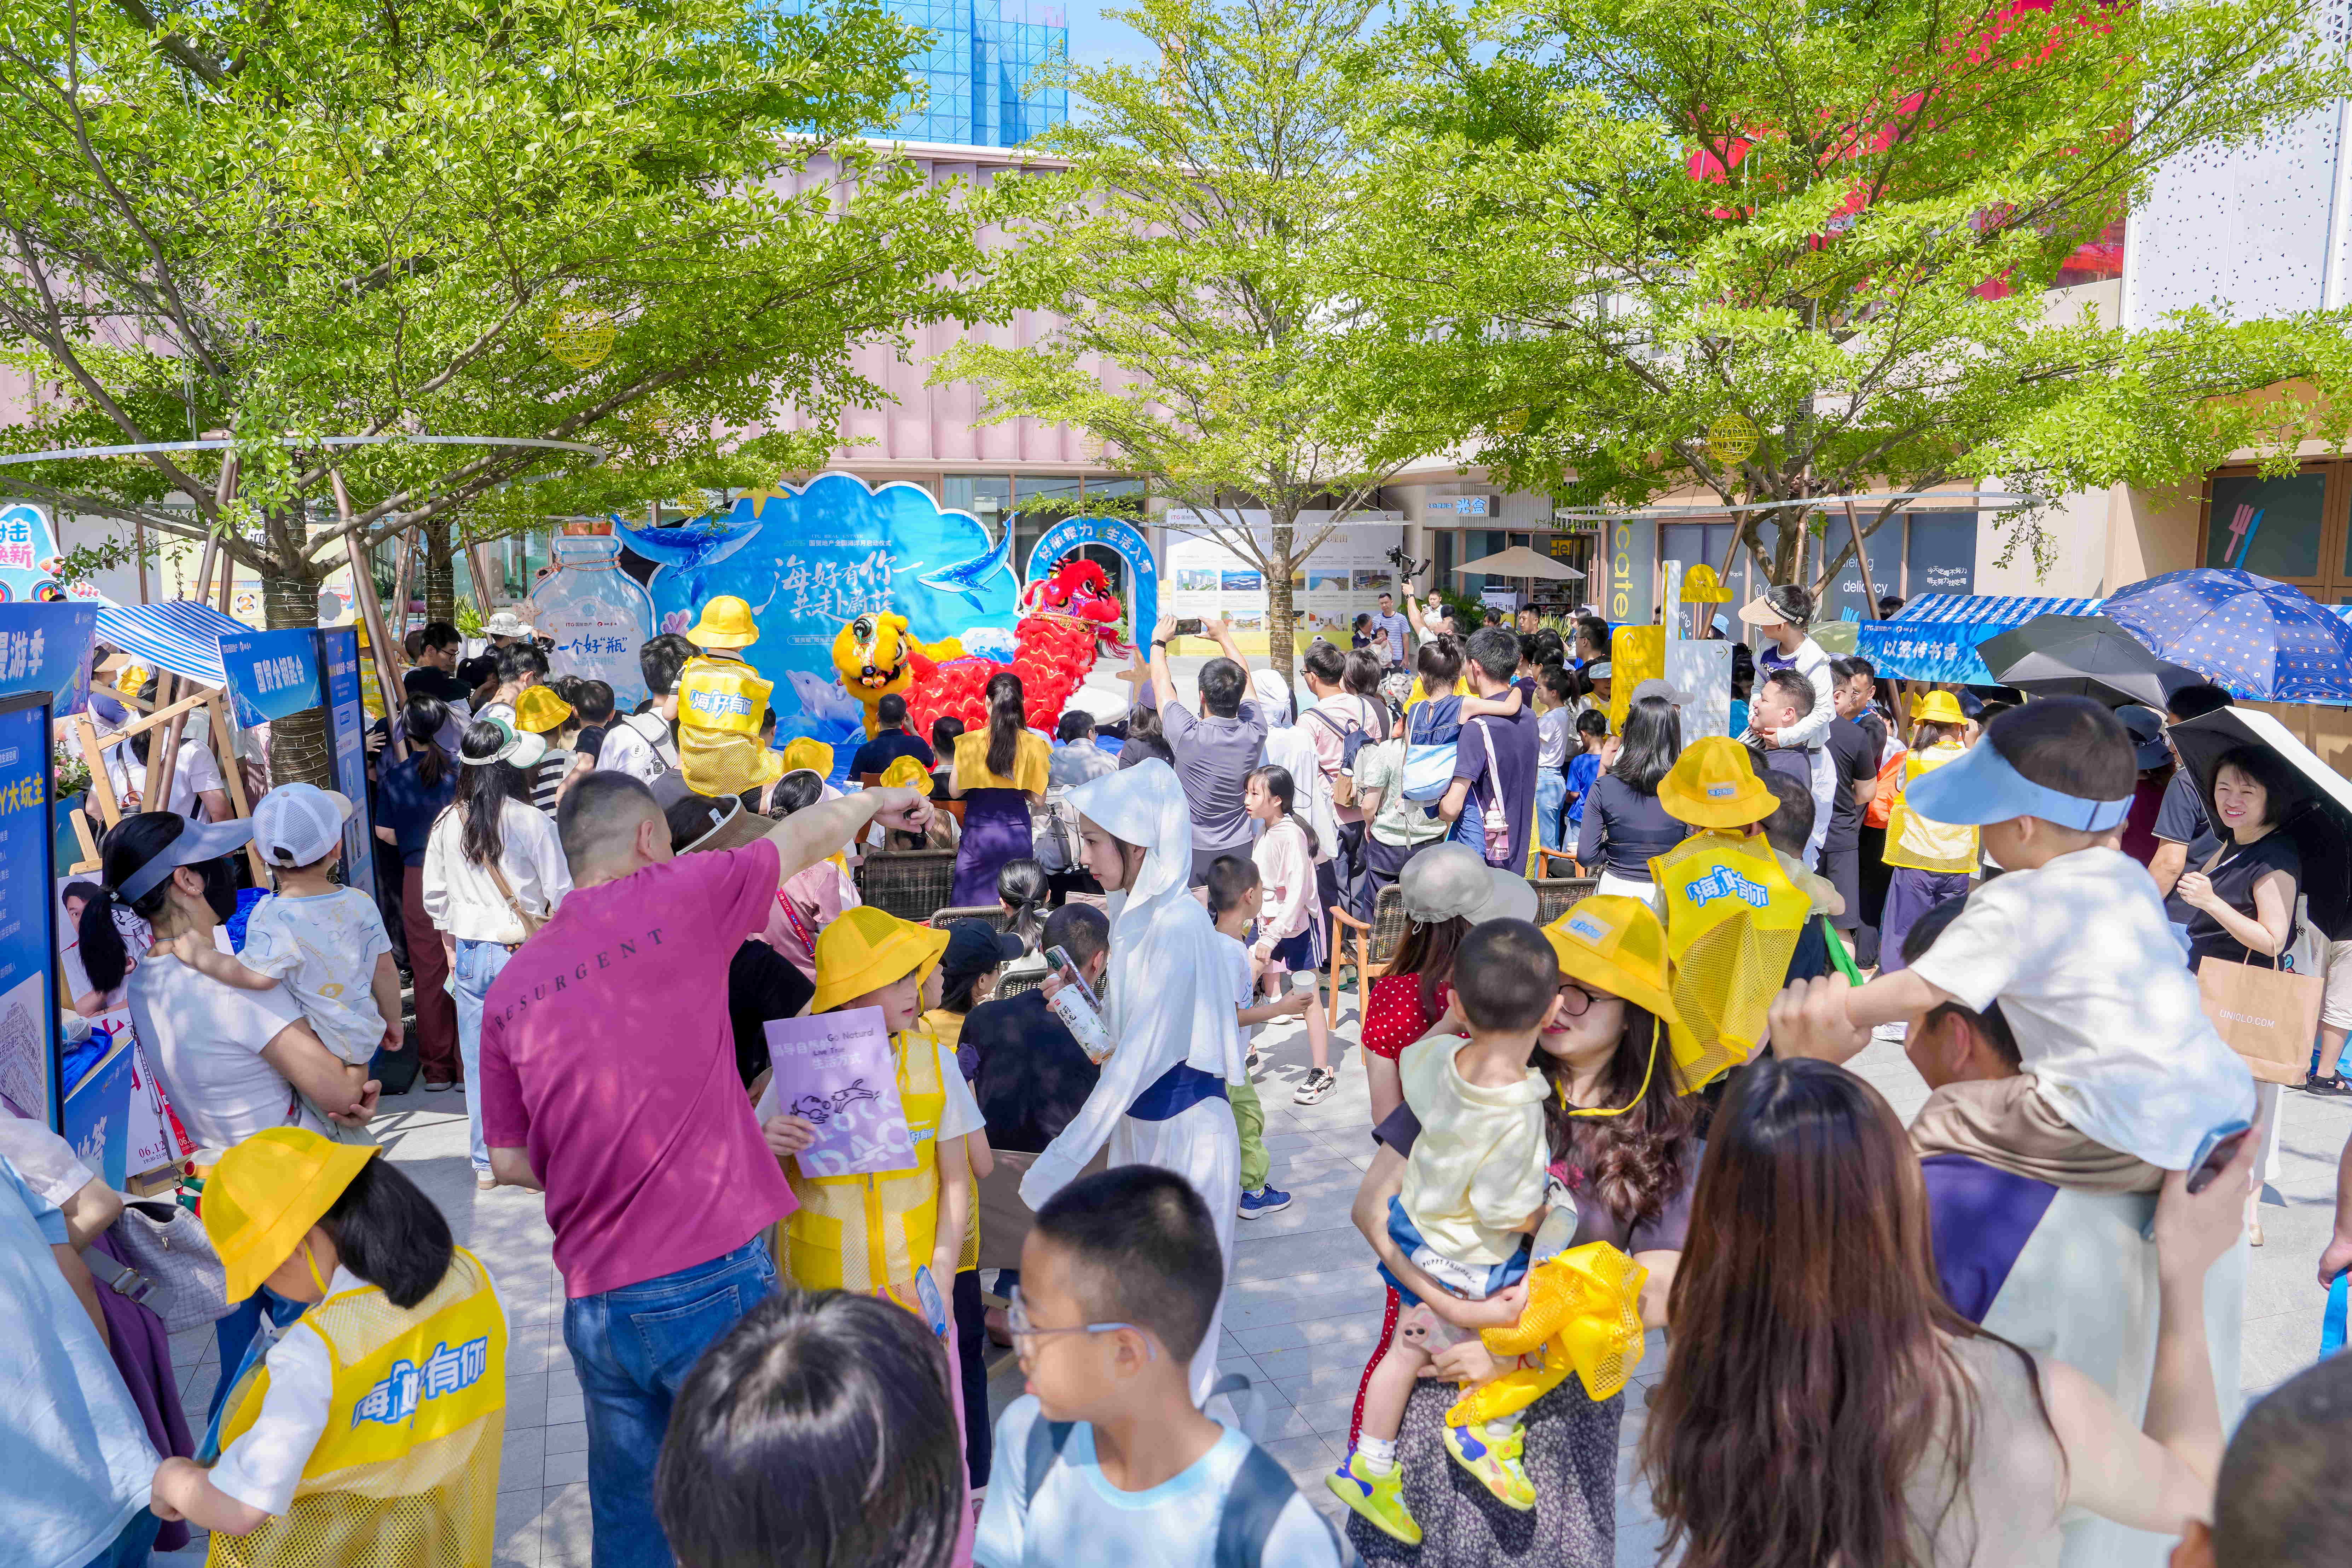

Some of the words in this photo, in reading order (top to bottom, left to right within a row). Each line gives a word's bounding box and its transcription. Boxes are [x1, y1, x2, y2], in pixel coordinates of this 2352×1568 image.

[1456, 497, 1486, 514] 光盒
[1613, 525, 1633, 623] cate
[1927, 565, 1967, 577] 今天吃喝不努力
[751, 549, 924, 616] 海好有你
[1843, 580, 1888, 596] deliccy
[1927, 577, 1967, 587] 明天努力找吃喝
[239, 597, 252, 610] 2
[495, 928, 663, 1032] RESURGENT
[2219, 1009, 2275, 1028] UNIQLO.COM
[827, 1034, 839, 1042] Go
[842, 1028, 874, 1040] Natural
[139, 1141, 166, 1158] 06.12
